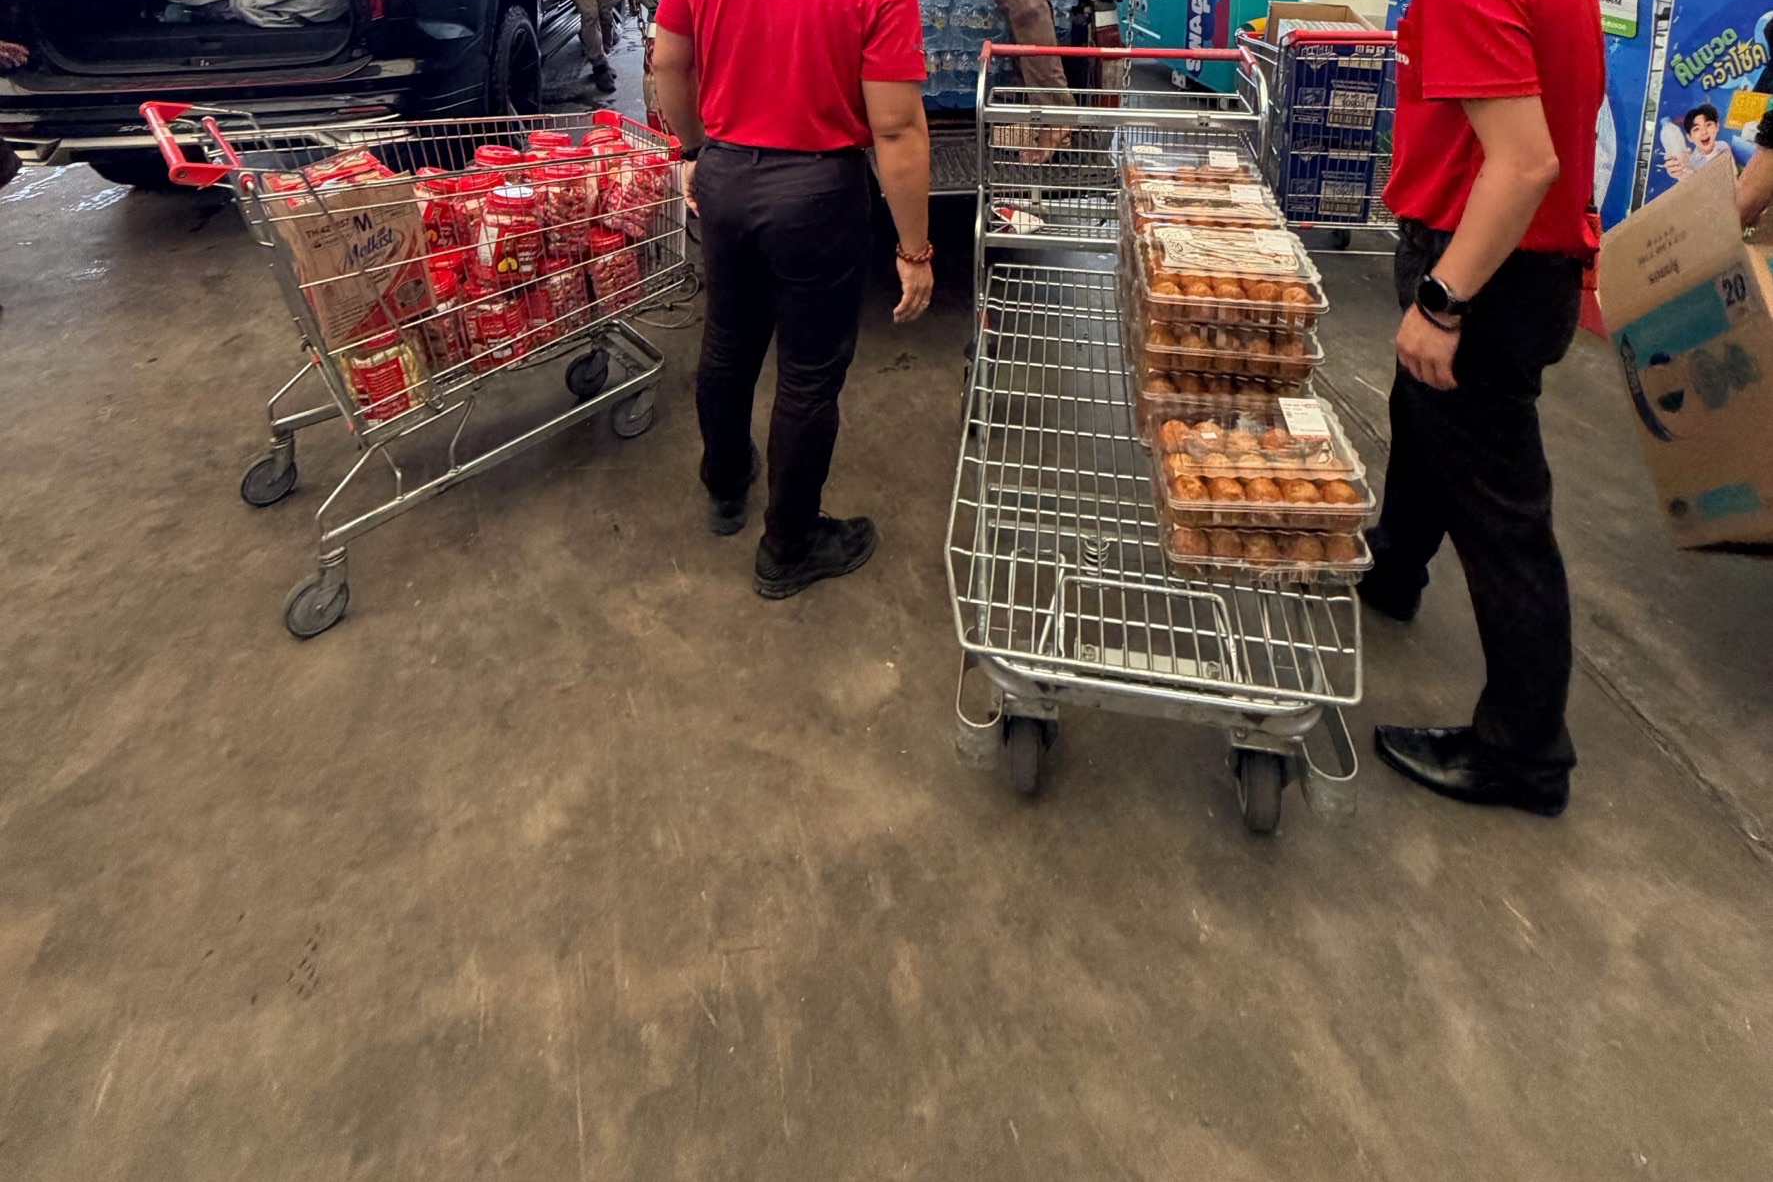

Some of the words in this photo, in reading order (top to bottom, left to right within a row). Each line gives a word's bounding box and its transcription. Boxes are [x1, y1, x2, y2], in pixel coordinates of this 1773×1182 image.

[1670, 27, 1738, 88] คืนขวด
[1701, 42, 1768, 91] คว้าโชค
